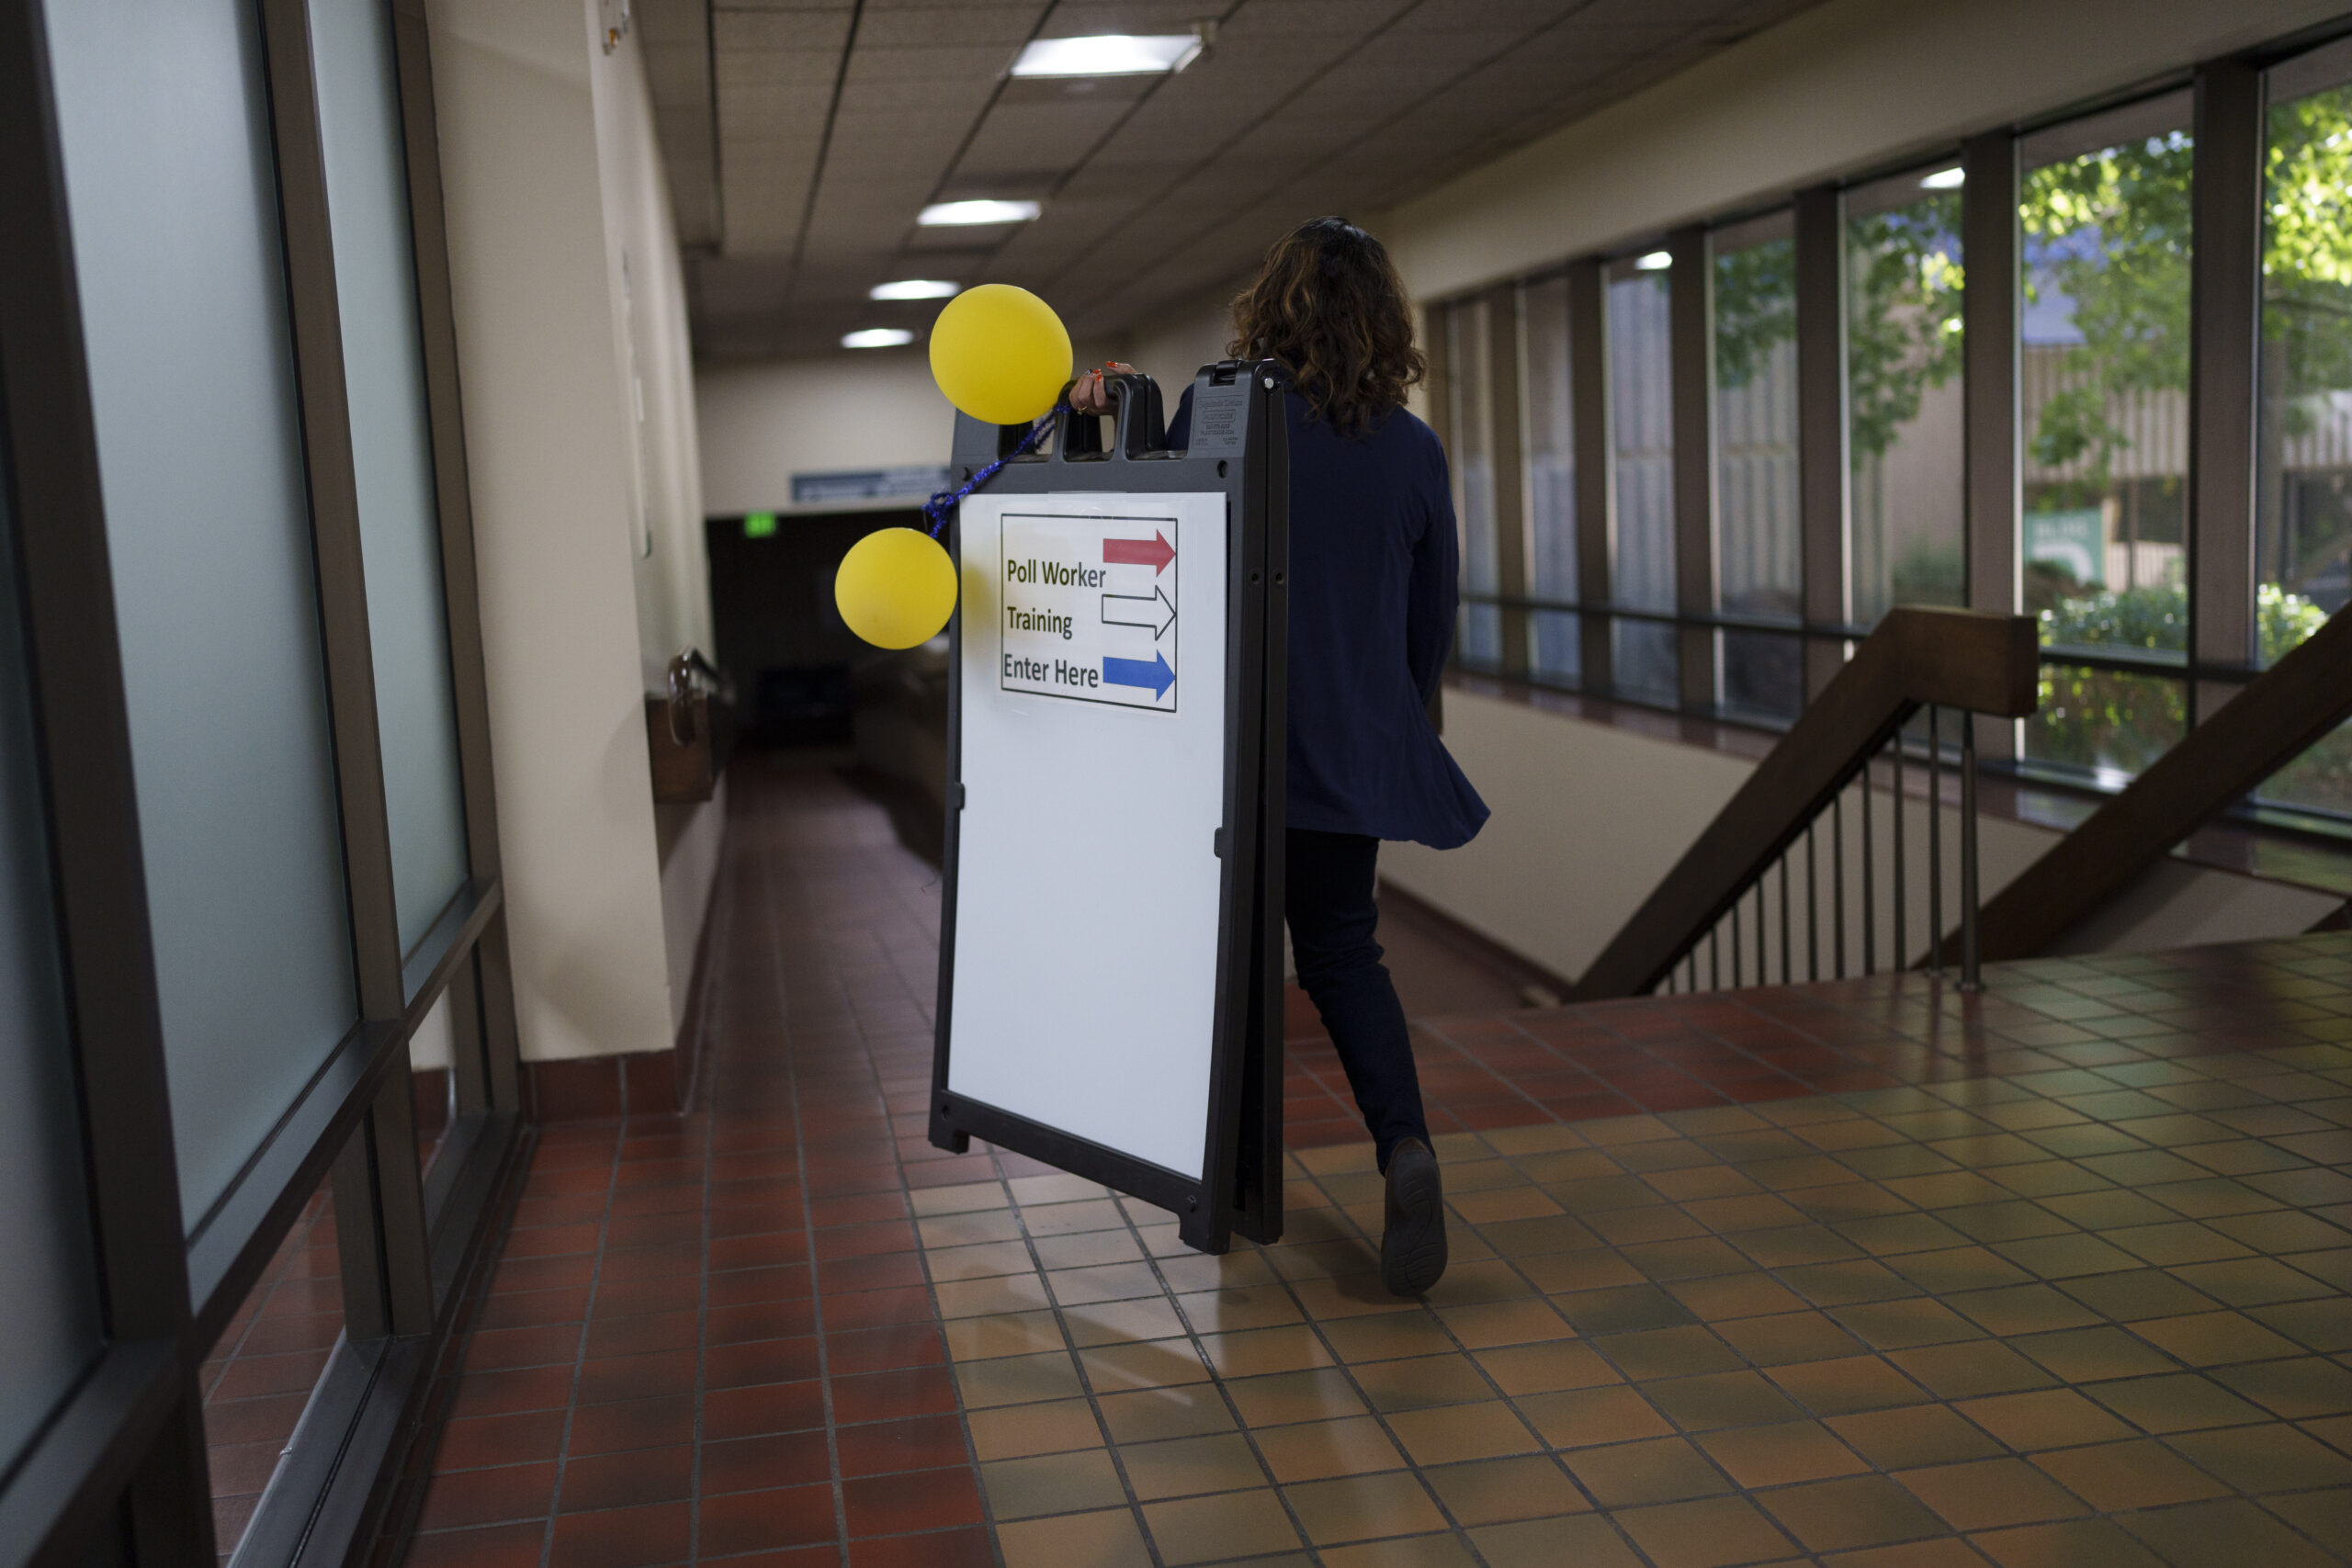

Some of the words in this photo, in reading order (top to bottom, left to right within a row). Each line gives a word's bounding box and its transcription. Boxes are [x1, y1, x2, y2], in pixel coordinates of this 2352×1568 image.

[1008, 558, 1036, 583] Poll
[1042, 561, 1106, 588] Worker
[1007, 606, 1073, 640] Training
[1004, 653, 1049, 682] Enter
[1056, 659, 1099, 688] Here
